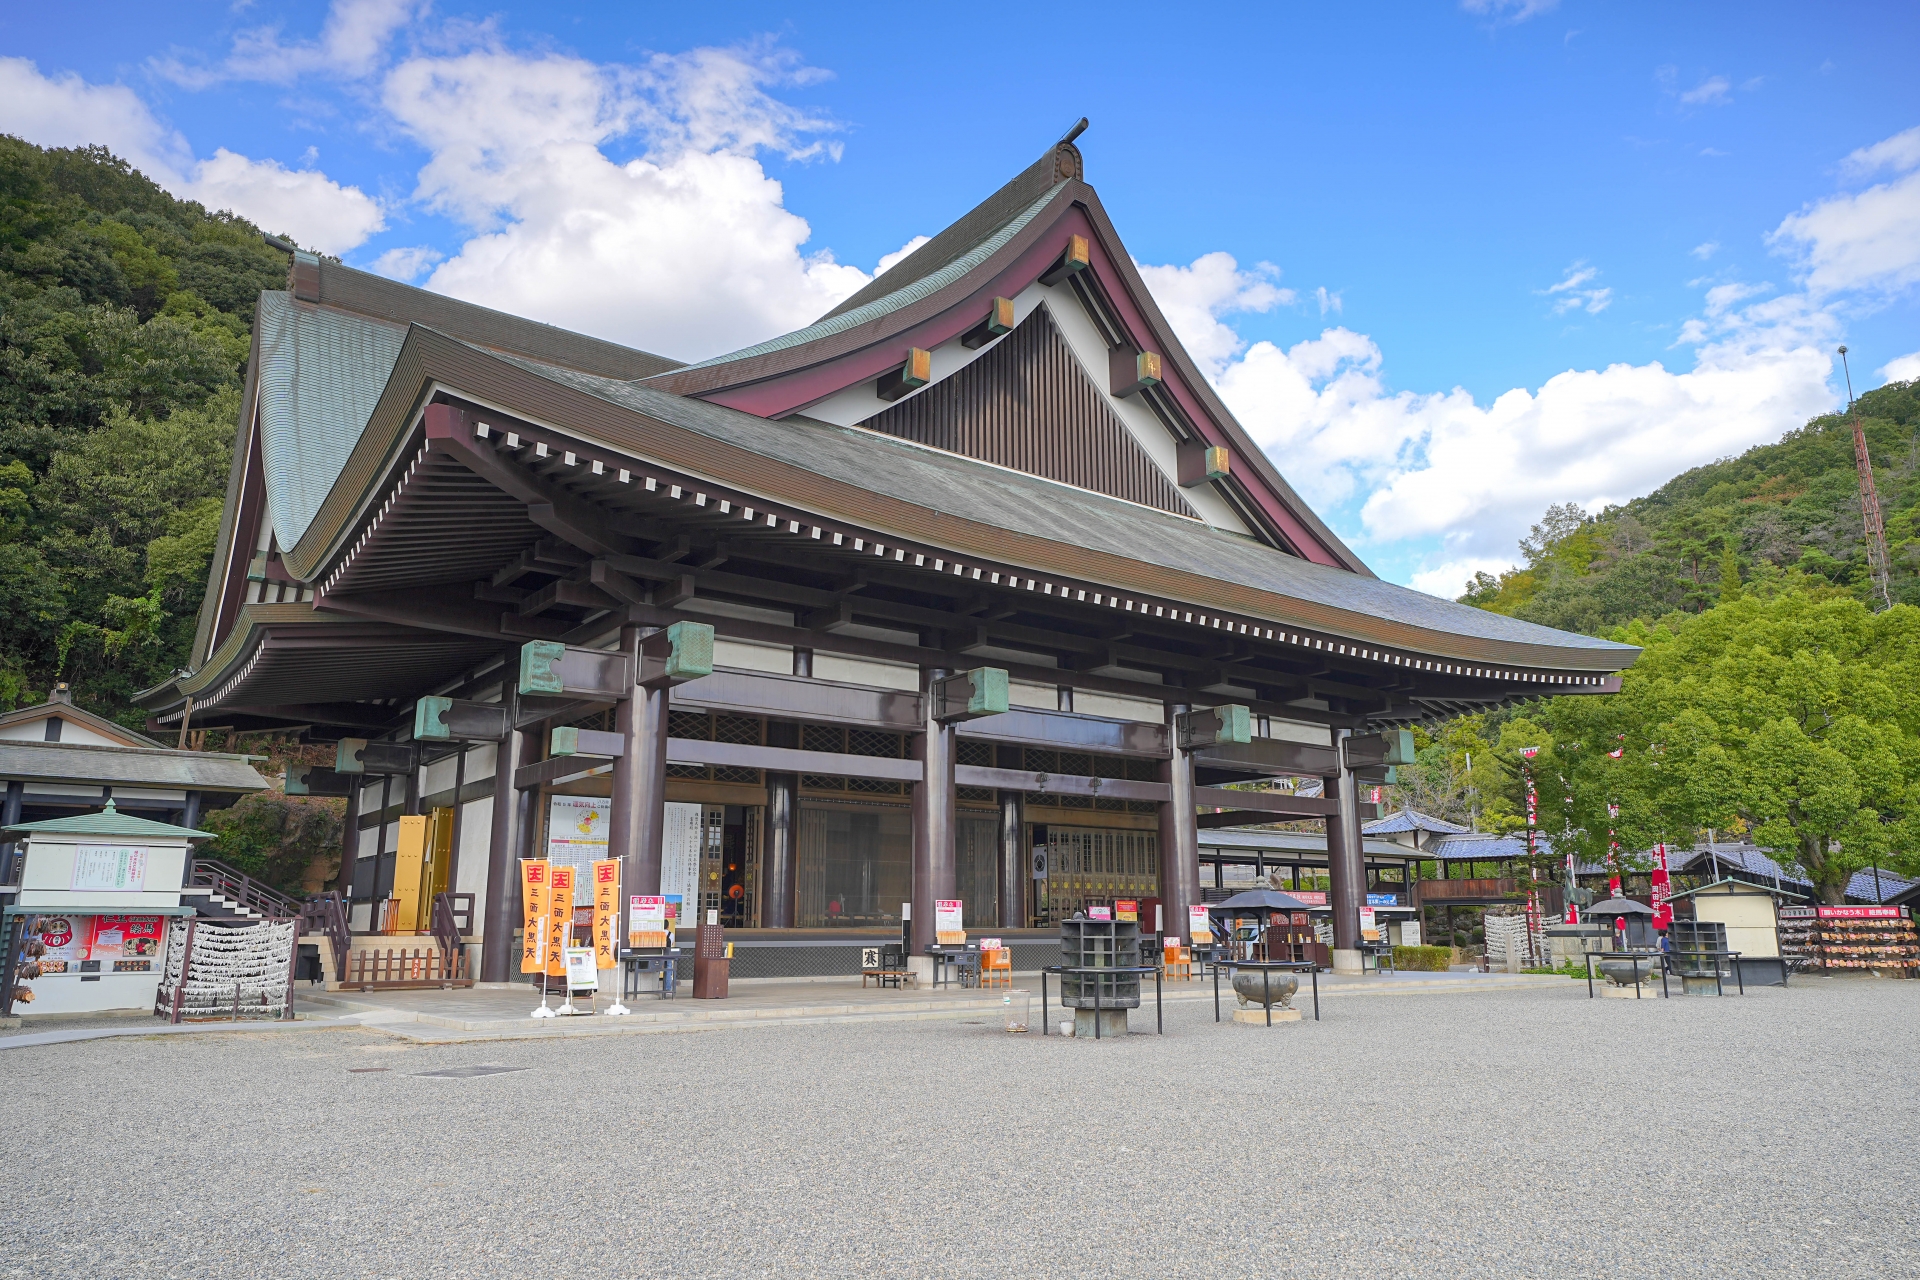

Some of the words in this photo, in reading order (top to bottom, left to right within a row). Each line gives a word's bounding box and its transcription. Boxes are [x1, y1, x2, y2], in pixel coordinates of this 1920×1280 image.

[525, 888, 539, 959] 三面大黒天
[549, 893, 565, 962] 三面大黒天
[599, 887, 611, 956] 三面大黒天
